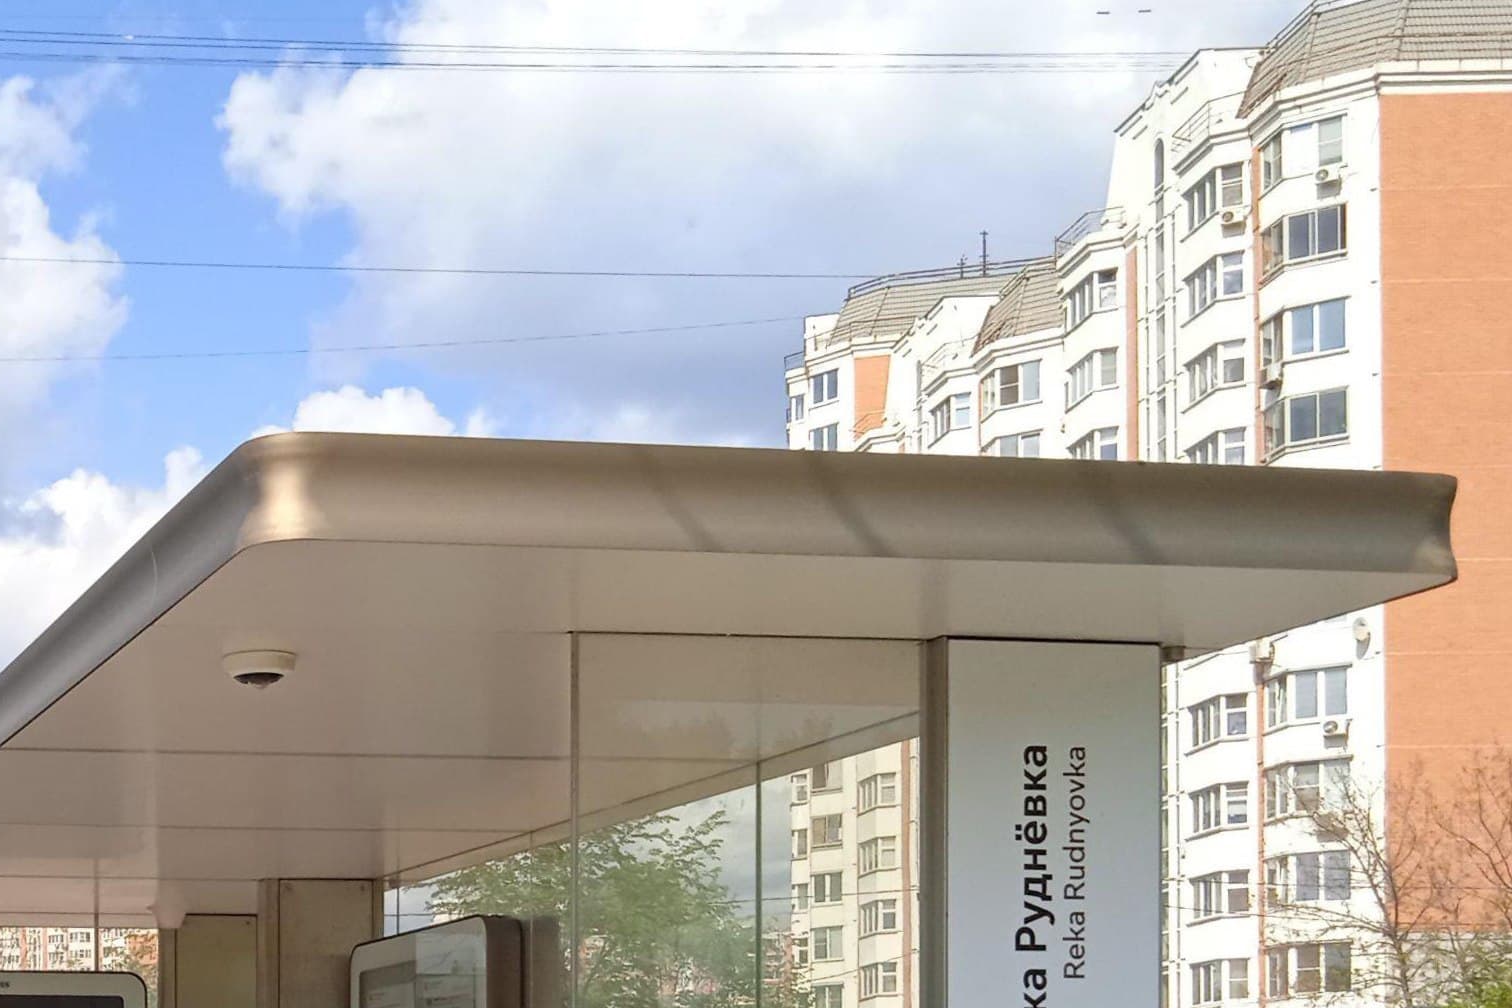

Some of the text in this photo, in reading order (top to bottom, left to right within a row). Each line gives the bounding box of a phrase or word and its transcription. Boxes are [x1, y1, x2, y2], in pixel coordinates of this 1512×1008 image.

[1014, 744, 1055, 952] Руднёвка
[1062, 745, 1090, 979] Reka Rudnyovka
